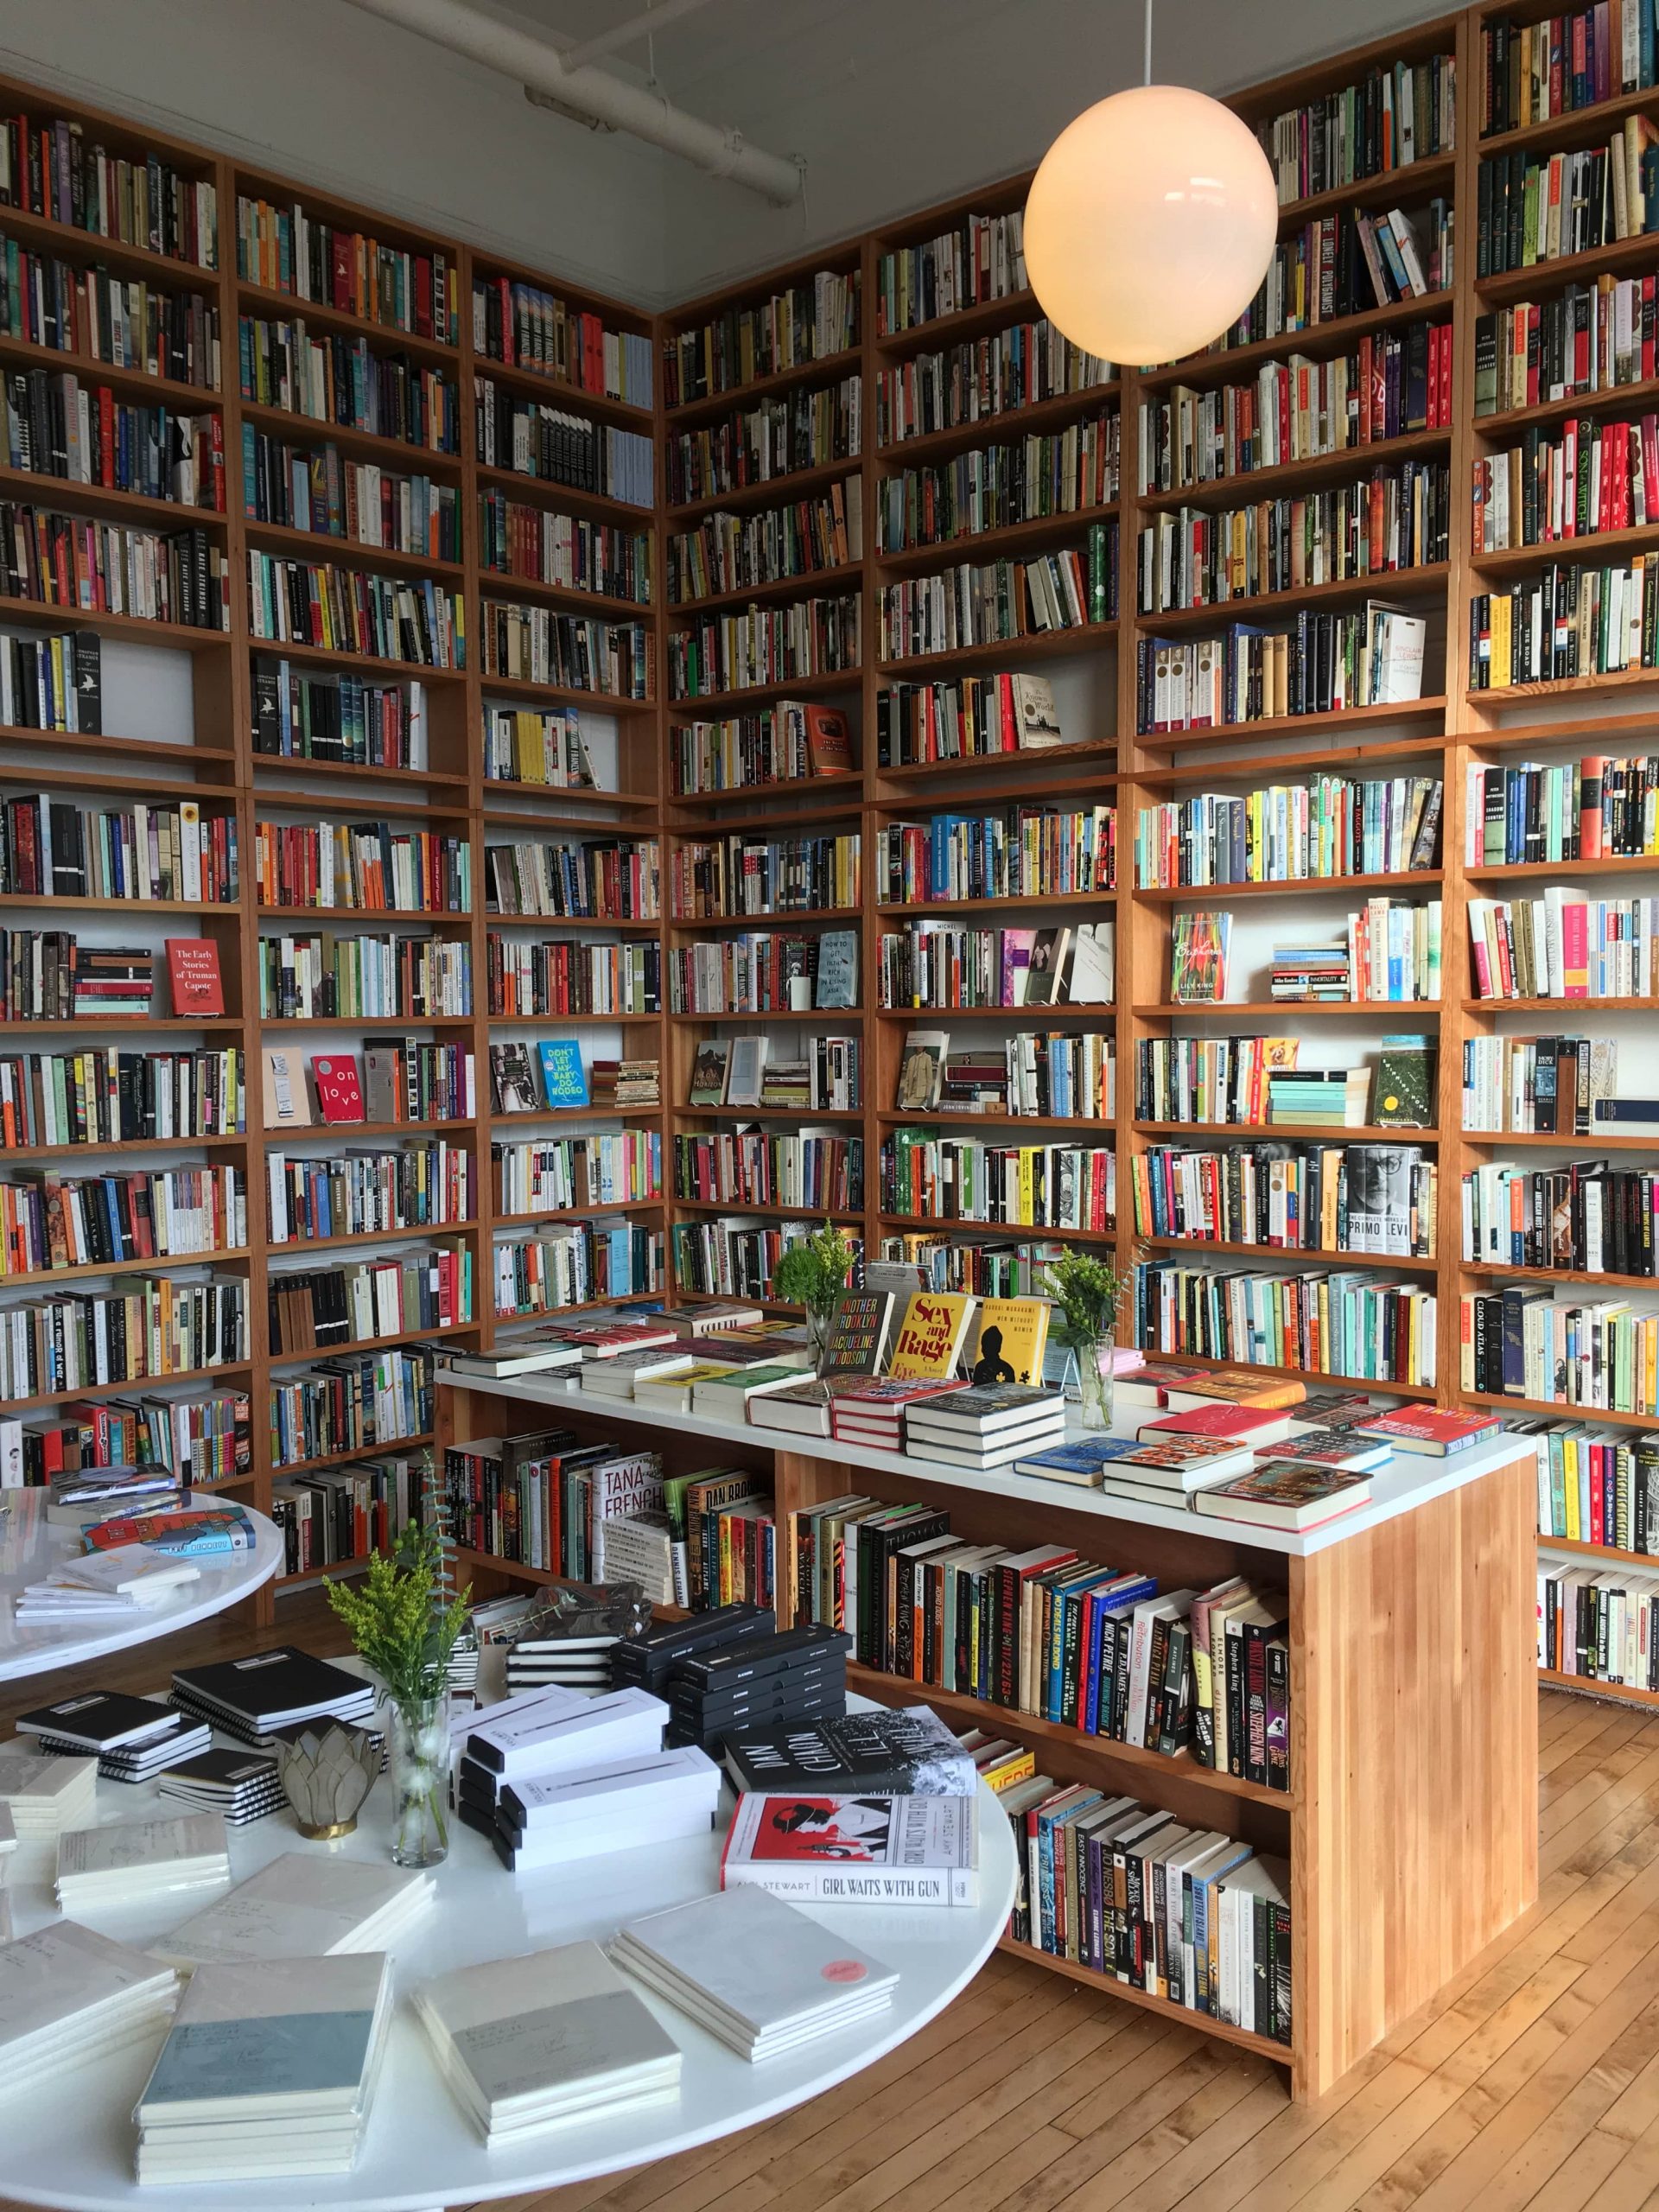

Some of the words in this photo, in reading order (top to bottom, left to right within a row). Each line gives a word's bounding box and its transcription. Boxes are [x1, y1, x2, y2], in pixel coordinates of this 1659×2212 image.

[1322, 217, 1333, 232] THE
[1322, 238, 1333, 264] LONELY
[1321, 270, 1333, 314] POLYGAMIST
[1578, 487, 1587, 521] WITCH
[176, 950, 191, 958] The
[194, 950, 213, 959] Early
[182, 960, 209, 969] Stories
[185, 982, 212, 991] Capote
[548, 1048, 574, 1057] DON'T
[1580, 1044, 1588, 1070] WHITE
[337, 1071, 355, 1081] on
[553, 1071, 576, 1080] BABY
[552, 1086, 582, 1096] RODEO
[1578, 1071, 1588, 1106] JACKET
[1349, 1221, 1380, 1236] PRIMO
[1386, 1222, 1408, 1236] LEVI
[915, 1236, 950, 1249] DENIS
[840, 1298, 878, 1313] ANOTHER
[912, 1297, 955, 1327] Sex
[835, 1314, 878, 1329] BROOKLYN
[926, 1325, 949, 1338] and
[830, 1335, 874, 1351] JACQUELINE
[897, 1330, 952, 1363] Rage
[830, 1351, 868, 1365] WOODSON
[605, 1465, 644, 1495] TANA
[606, 1486, 664, 1519] FRENCH
[706, 1488, 725, 1511] DAN
[191, 1541, 228, 1552] BENNETT
[675, 1576, 684, 1605] LEHANE
[1002, 1569, 1014, 1605] STEPHEN
[1105, 1622, 1115, 1645] NICK
[1103, 1646, 1114, 1673] PETRIE
[1230, 1641, 1239, 1675] Stephen
[1196, 1712, 1212, 1745] CHICAGO
[740, 1745, 790, 1769] DAN
[785, 1732, 842, 1771] CHAON
[907, 1811, 926, 1828] WITH
[904, 1848, 924, 1864] GIRL
[764, 1882, 810, 1891] STEWART
[823, 1878, 845, 1896] GIRL
[848, 1878, 880, 1896] WAITS
[882, 1878, 914, 1897] WITH
[918, 1879, 939, 1897] GUN
[1105, 1910, 1114, 1929] THE
[1104, 1932, 1116, 1958] SON
